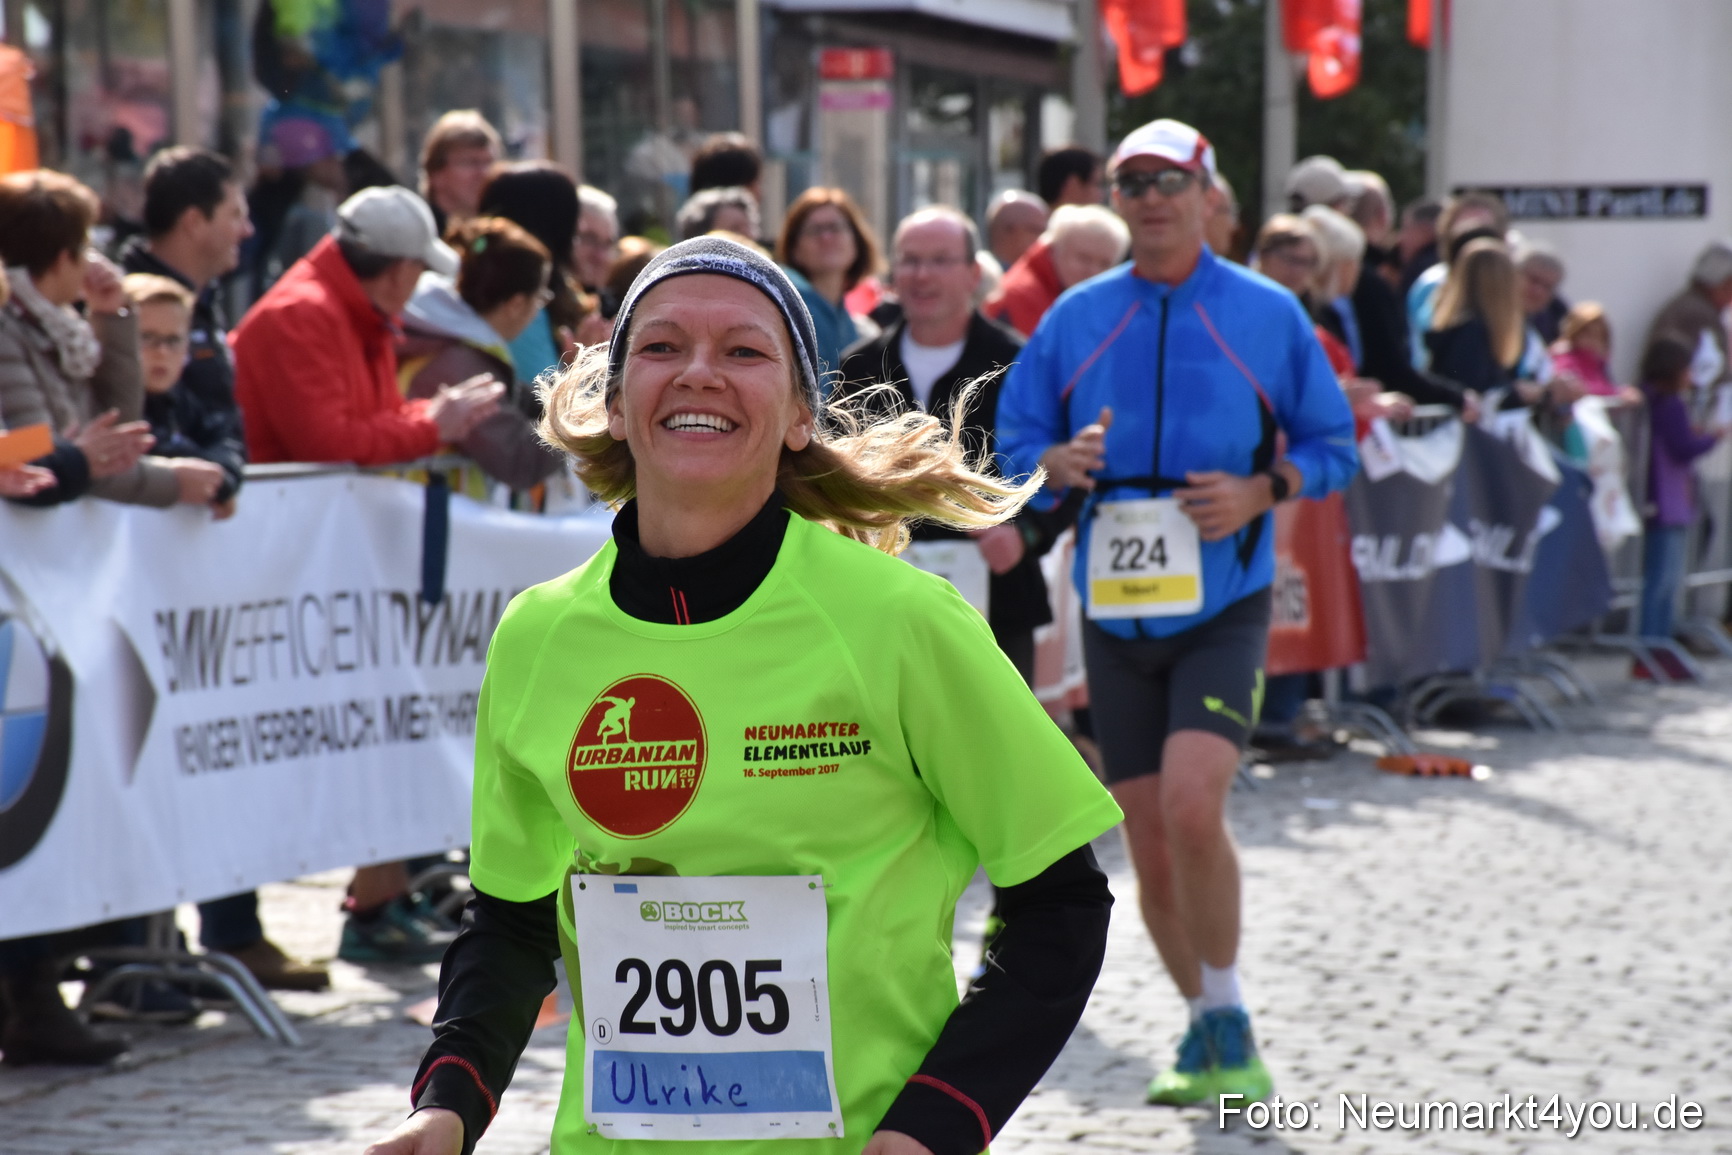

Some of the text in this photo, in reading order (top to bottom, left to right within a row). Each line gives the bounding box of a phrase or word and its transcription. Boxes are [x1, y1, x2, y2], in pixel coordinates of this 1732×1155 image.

[1109, 536, 1168, 571] 224
[744, 722, 860, 740] NEUMARKTER
[575, 744, 696, 766] URBANIAN
[743, 740, 872, 762] ELEMENTELAUF
[624, 769, 678, 791] RUN
[743, 764, 840, 779] 16. September 2017
[663, 901, 748, 922] BOCK
[615, 958, 790, 1036] 2905
[598, 1025, 606, 1038] D
[611, 1060, 748, 1107] Ulrike
